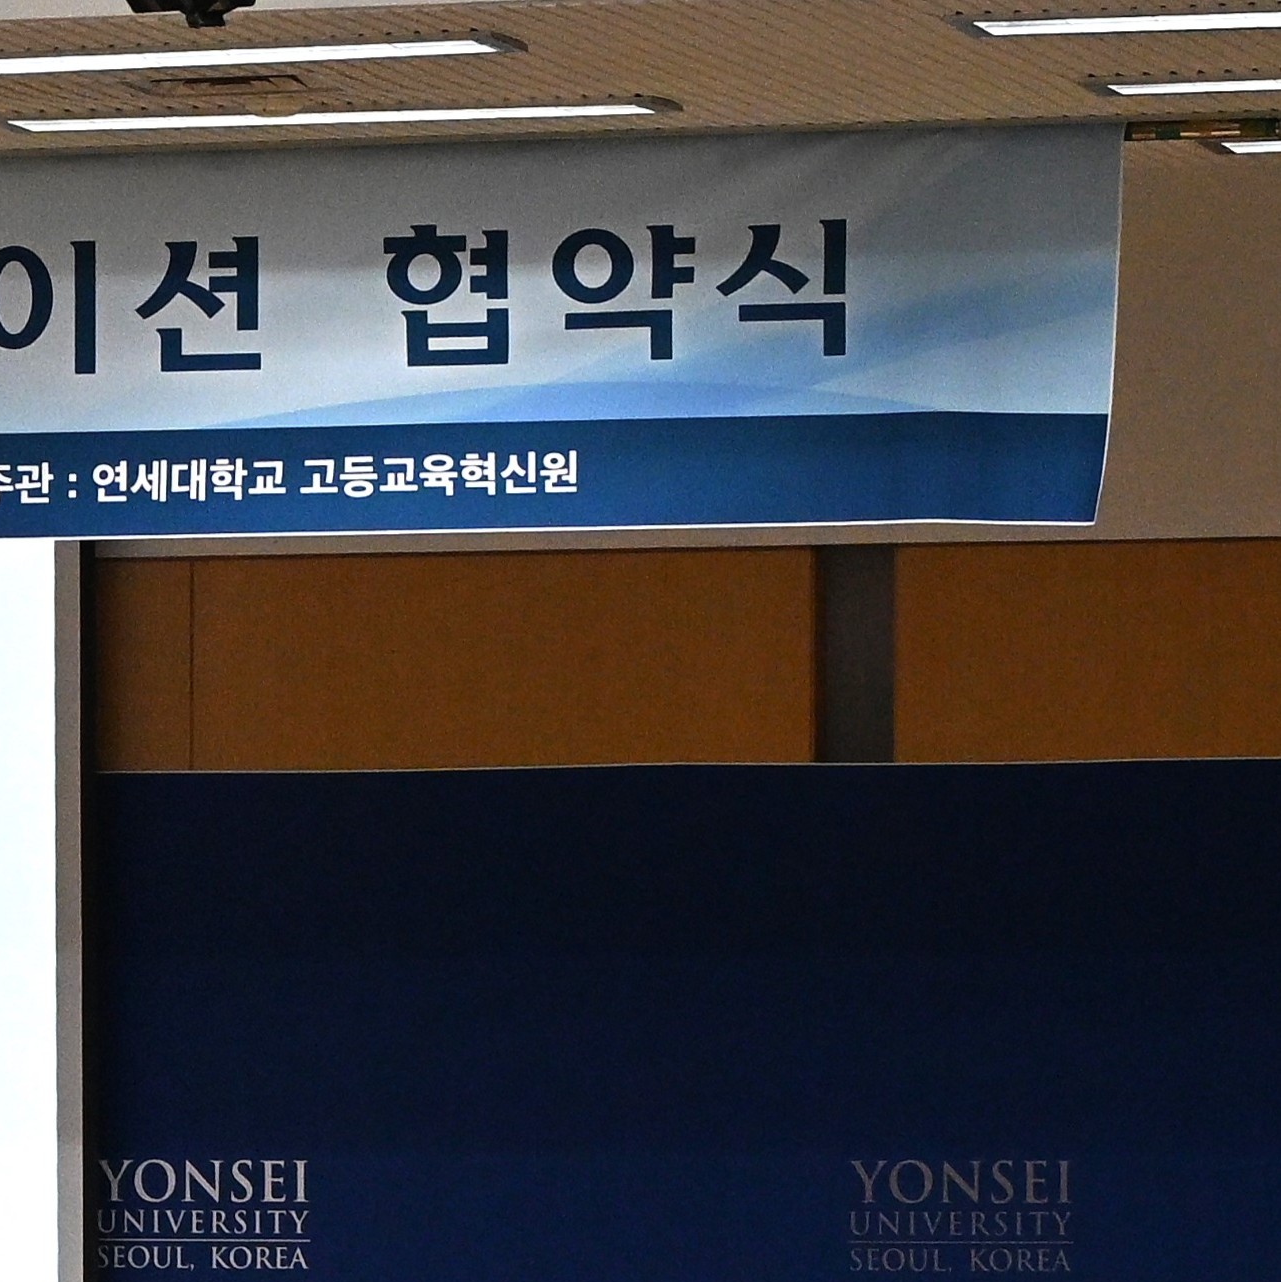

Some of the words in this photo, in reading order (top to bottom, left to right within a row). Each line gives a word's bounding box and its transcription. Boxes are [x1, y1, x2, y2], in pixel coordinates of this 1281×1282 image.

[382, 218, 848, 367] 협약식
[92, 457, 287, 503] 연세대학교
[299, 449, 578, 498] 고등교육혁신원
[101, 1158, 308, 1204] YONSEI
[850, 1159, 1071, 1205] YONSEI
[97, 1208, 309, 1235] UNIVERSITY
[850, 1210, 1072, 1237] UNIVERSITY
[98, 1245, 195, 1271] SEOUL,
[211, 1245, 309, 1270] KOREA
[970, 1248, 1071, 1273] KOREA
